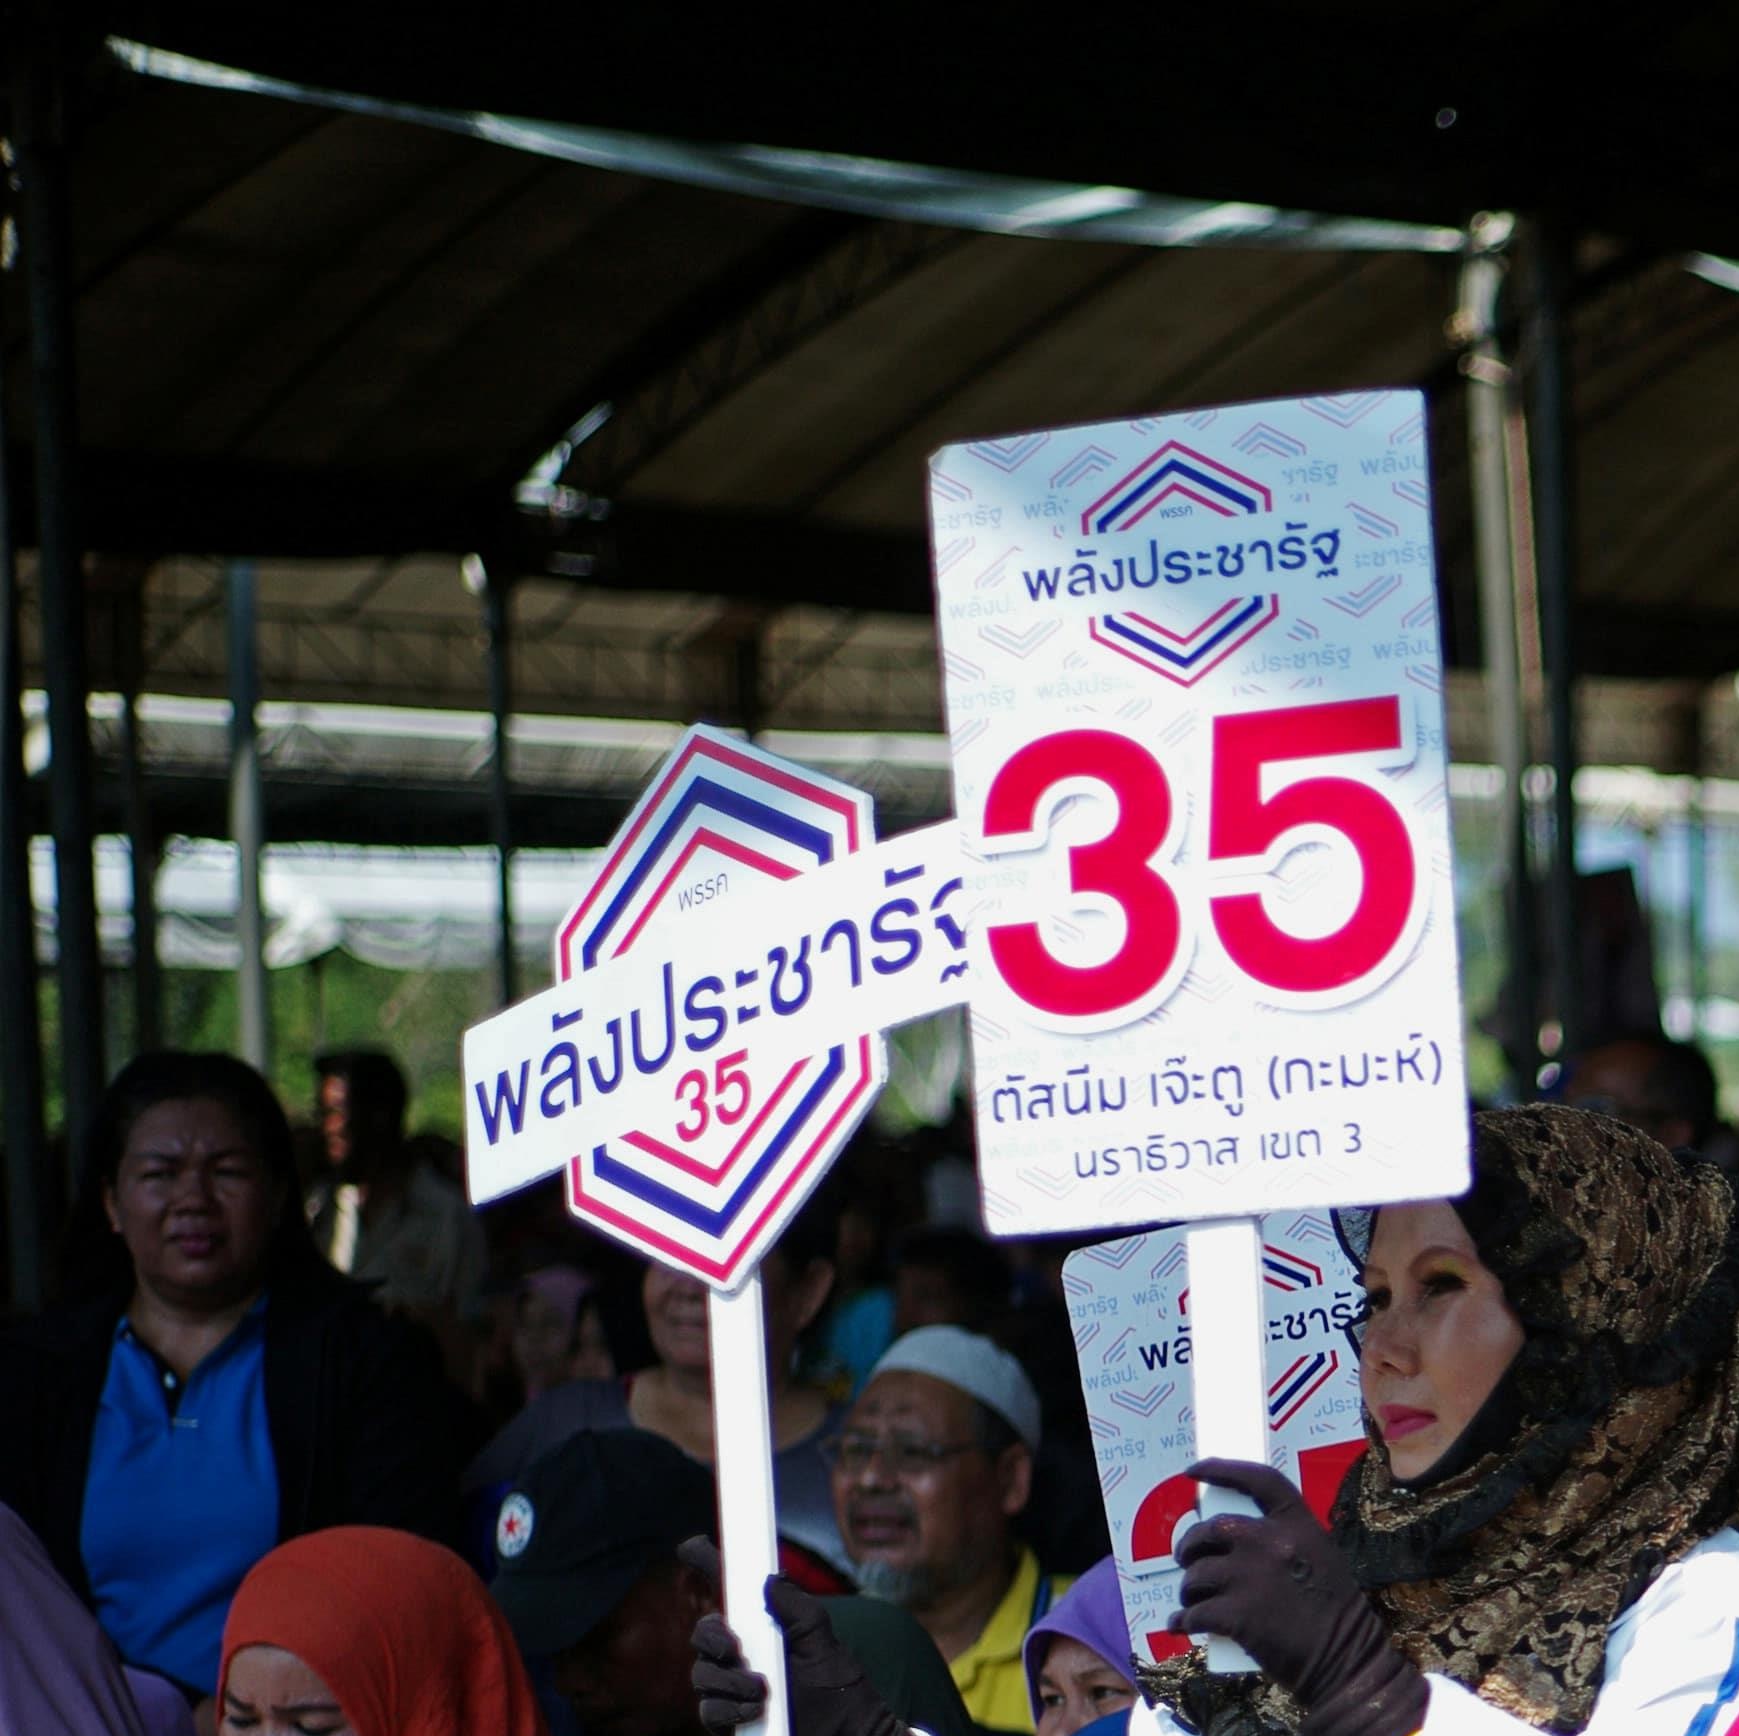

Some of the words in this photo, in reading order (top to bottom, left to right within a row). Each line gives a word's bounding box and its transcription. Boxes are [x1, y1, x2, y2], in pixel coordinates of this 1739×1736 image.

[1160, 504, 1192, 520] พรรค
[1022, 522, 1340, 602] พลังประชารัฐ
[982, 694, 1416, 1017] 35
[678, 872, 728, 912] พรรค
[674, 1048, 751, 1143] 35
[992, 1065, 1125, 1123] ตัสนีม
[1151, 1056, 1243, 1116] เจ๊ะตู
[1075, 1134, 1239, 1178] นราธิวาส
[1261, 1128, 1321, 1161] เขต
[1344, 1123, 1362, 1153] 3
